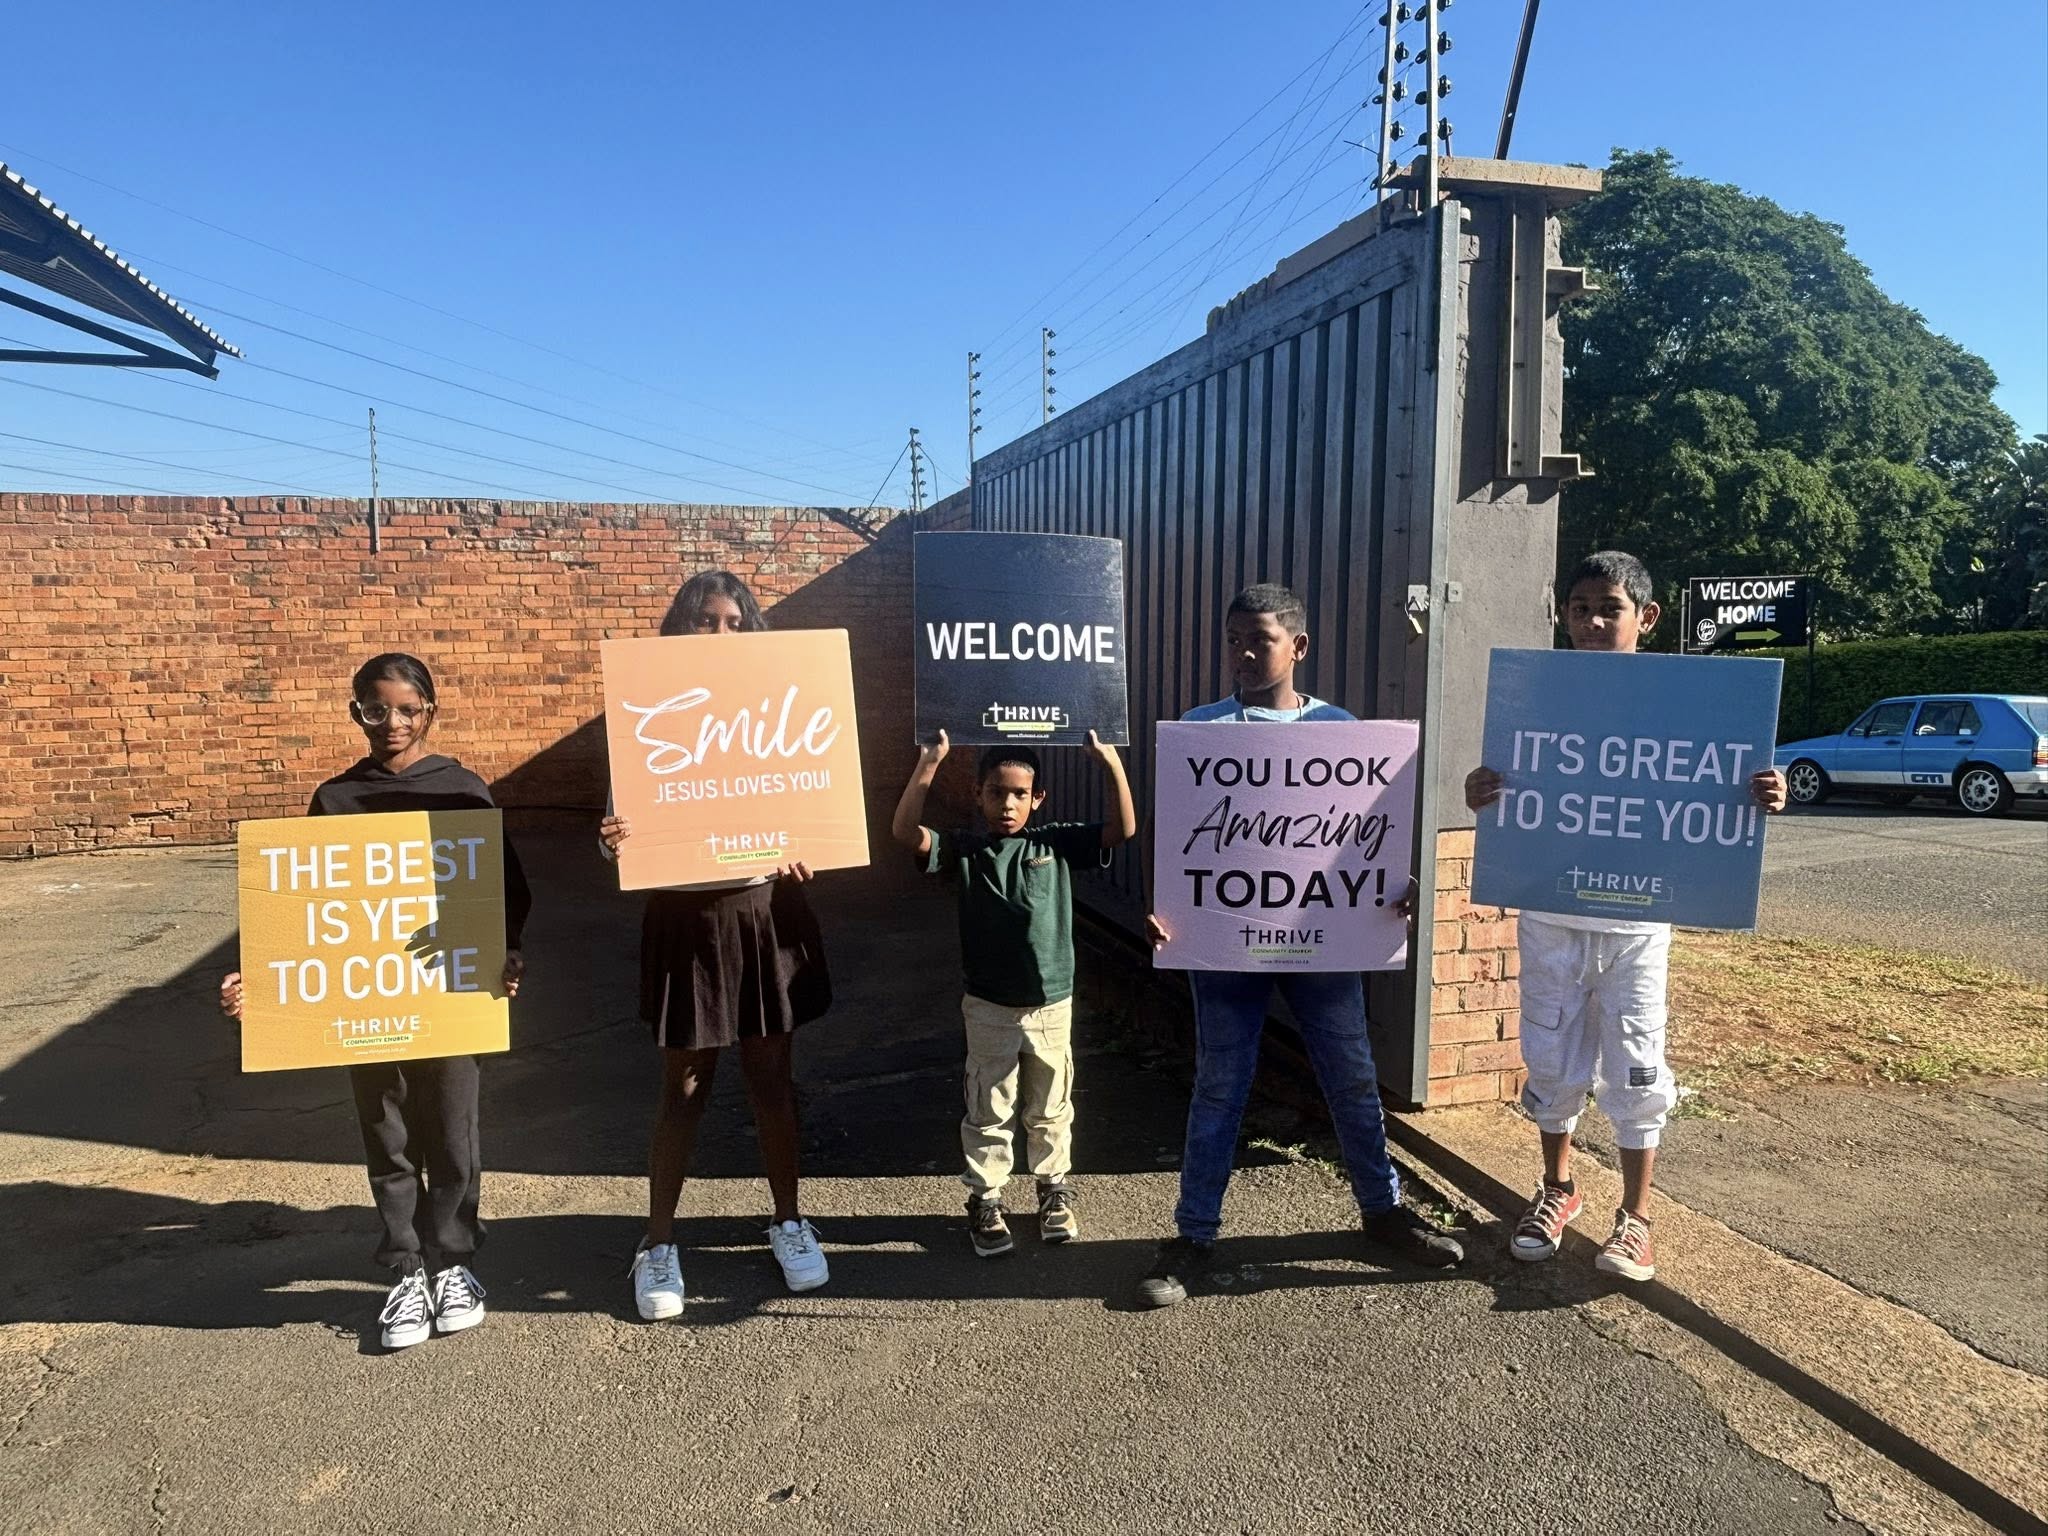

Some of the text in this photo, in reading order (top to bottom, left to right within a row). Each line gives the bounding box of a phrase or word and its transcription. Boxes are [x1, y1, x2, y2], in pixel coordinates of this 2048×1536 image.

[1700, 580, 1796, 601] WELCOME
[1717, 604, 1776, 624] HOME
[926, 622, 1115, 663] WELCOME
[621, 684, 842, 775] Smile
[1187, 757, 1391, 787] YOU LOOK
[1512, 730, 1753, 785] IT'S GREAT
[654, 769, 831, 804] JESUS LOVES YOU!
[1182, 795, 1395, 861] Amazing
[1496, 788, 1757, 847] TO SEE YOU!
[260, 838, 485, 891] THE BEST
[1183, 868, 1386, 909] TODAY!
[306, 895, 445, 946] IS YET
[268, 948, 478, 1005] TO COME
